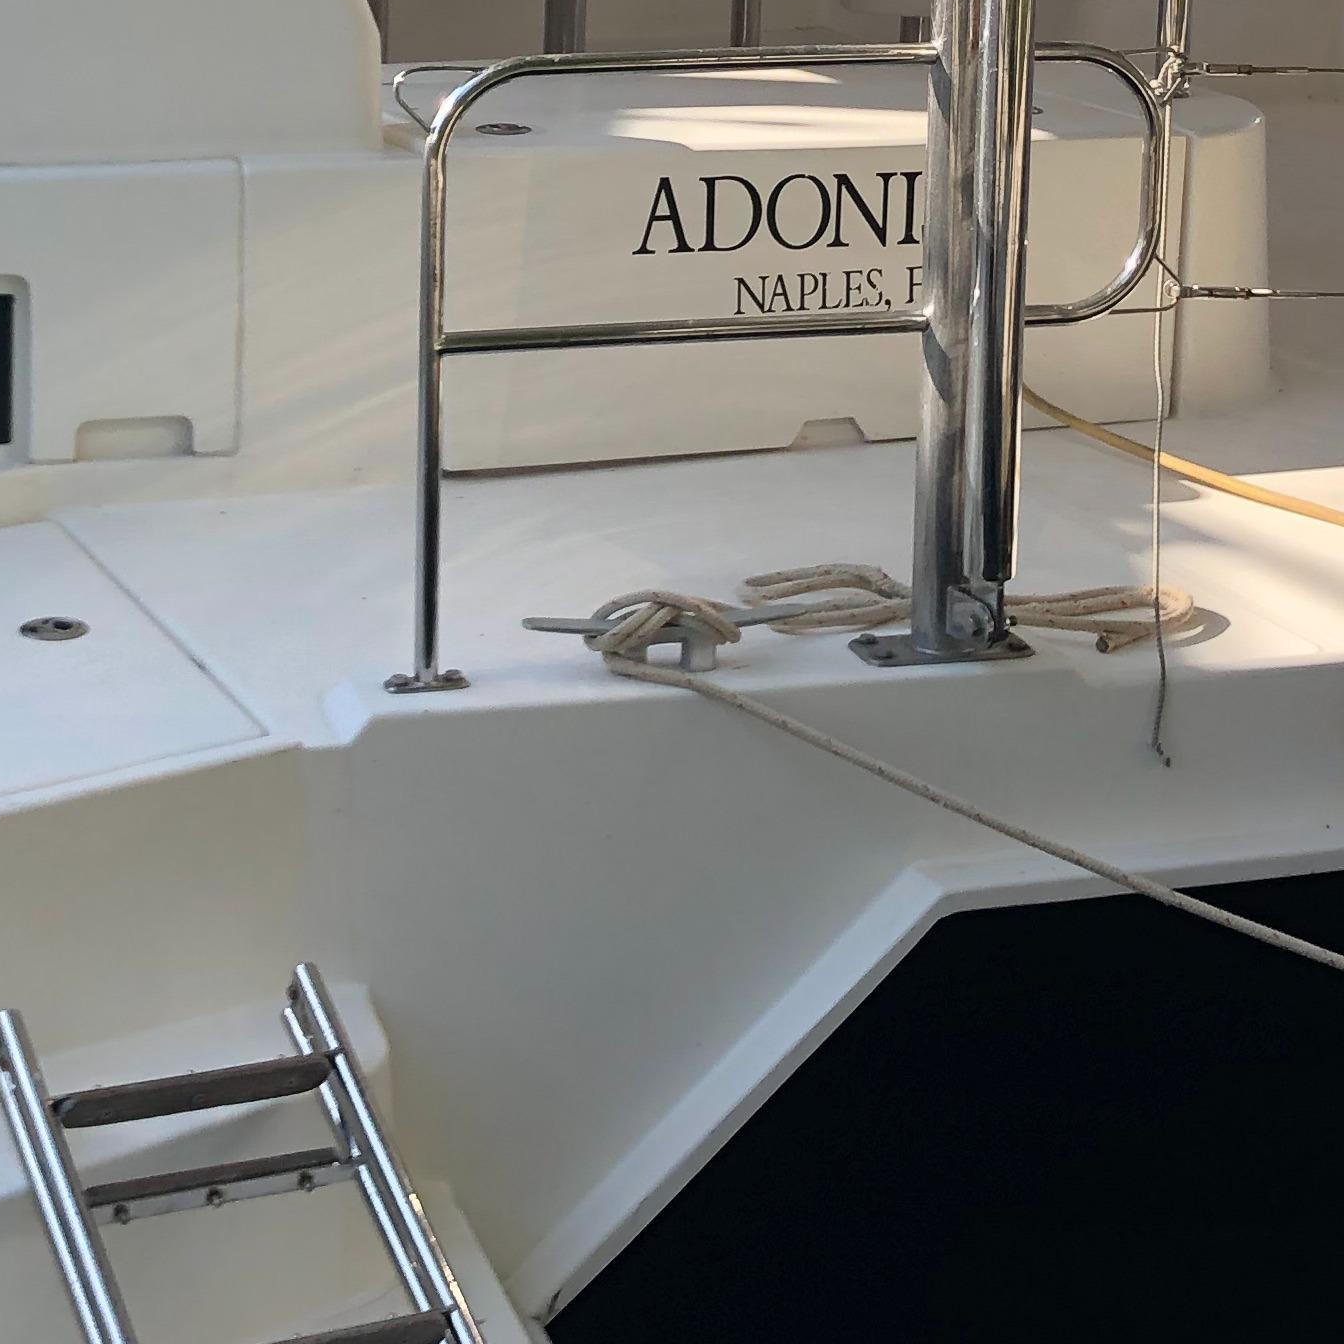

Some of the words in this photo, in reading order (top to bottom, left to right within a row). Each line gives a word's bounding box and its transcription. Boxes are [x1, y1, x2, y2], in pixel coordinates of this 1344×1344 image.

[632, 170, 924, 255] ADONI
[734, 267, 892, 315] NAPLES,
[905, 265, 923, 305] F
